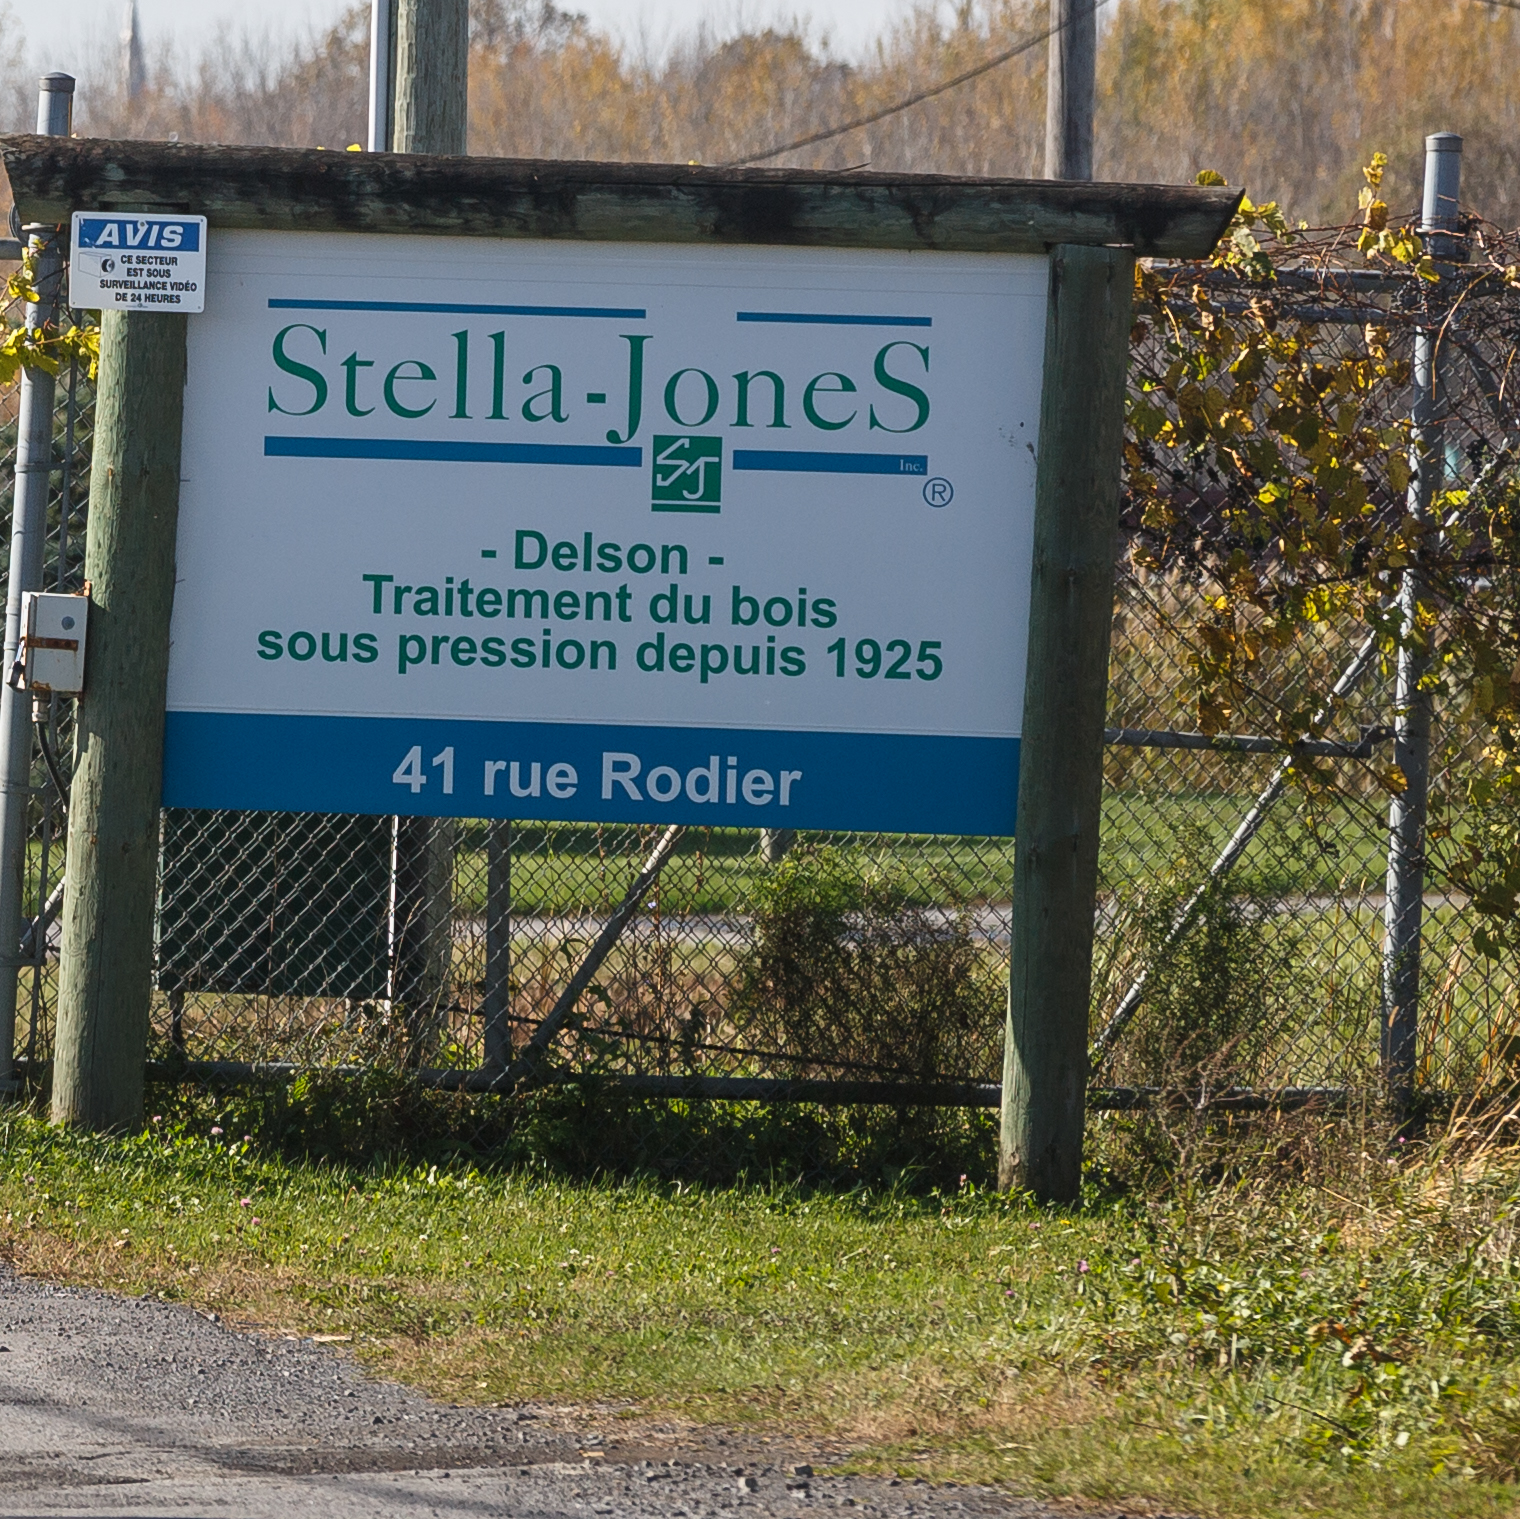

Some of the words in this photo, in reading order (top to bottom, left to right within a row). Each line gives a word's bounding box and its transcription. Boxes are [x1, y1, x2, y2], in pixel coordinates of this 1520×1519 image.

[96, 223, 184, 248] AVIS
[120, 254, 133, 265] CE
[135, 255, 178, 267] SECTEUR
[126, 267, 144, 278] EST
[146, 268, 172, 279] SOUS
[99, 279, 167, 290] SURVEILLANCE
[170, 279, 198, 292] VIDÉO
[115, 292, 128, 302] DE
[130, 292, 142, 303] 24
[144, 293, 181, 304] HEURES
[267, 324, 932, 445] Stella-JoneS
[899, 459, 924, 472] Inc.
[513, 529, 690, 574] Delson
[362, 573, 632, 623] Traitement
[648, 586, 712, 626] du
[730, 585, 839, 629] bois
[256, 629, 379, 664] sous
[397, 629, 618, 675] pression
[635, 631, 807, 684] depuis
[826, 637, 944, 681] 1925
[392, 745, 456, 795] 41
[483, 755, 579, 799] rue
[600, 751, 803, 806] Rodier
